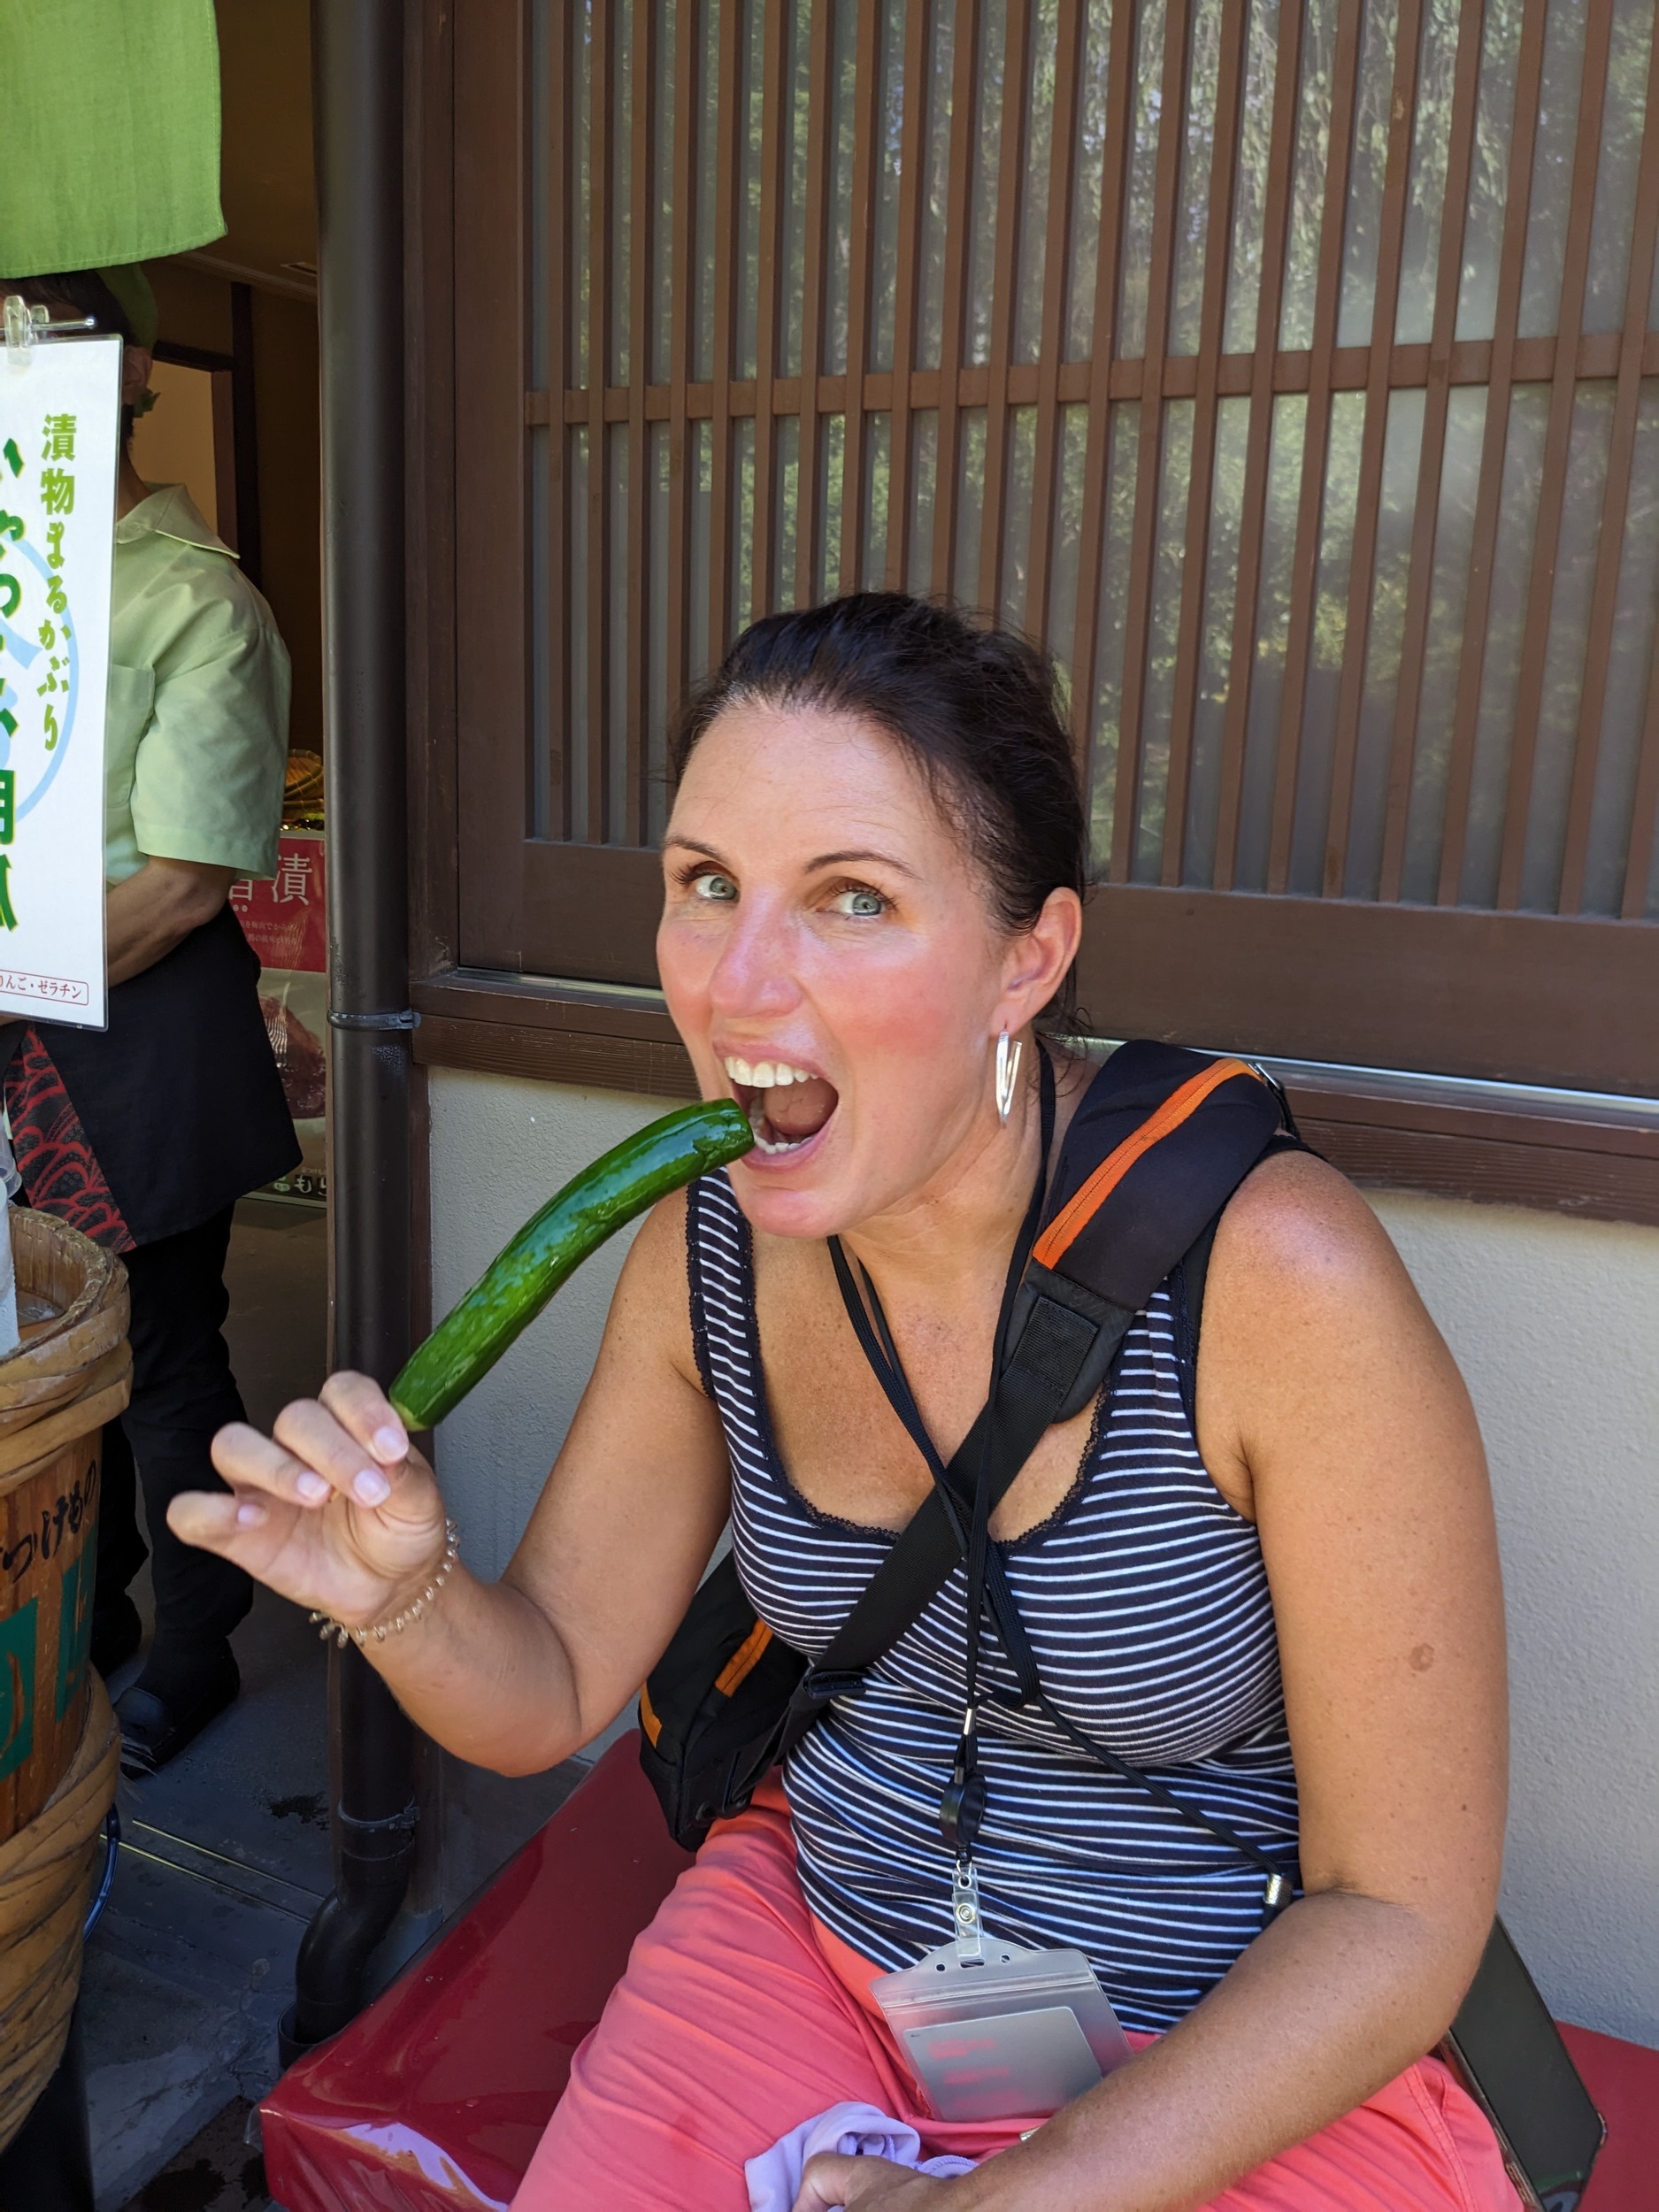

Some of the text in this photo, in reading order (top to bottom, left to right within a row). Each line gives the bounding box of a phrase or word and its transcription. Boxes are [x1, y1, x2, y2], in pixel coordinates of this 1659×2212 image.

[37, 413, 77, 750] 漬物まるかぶり
